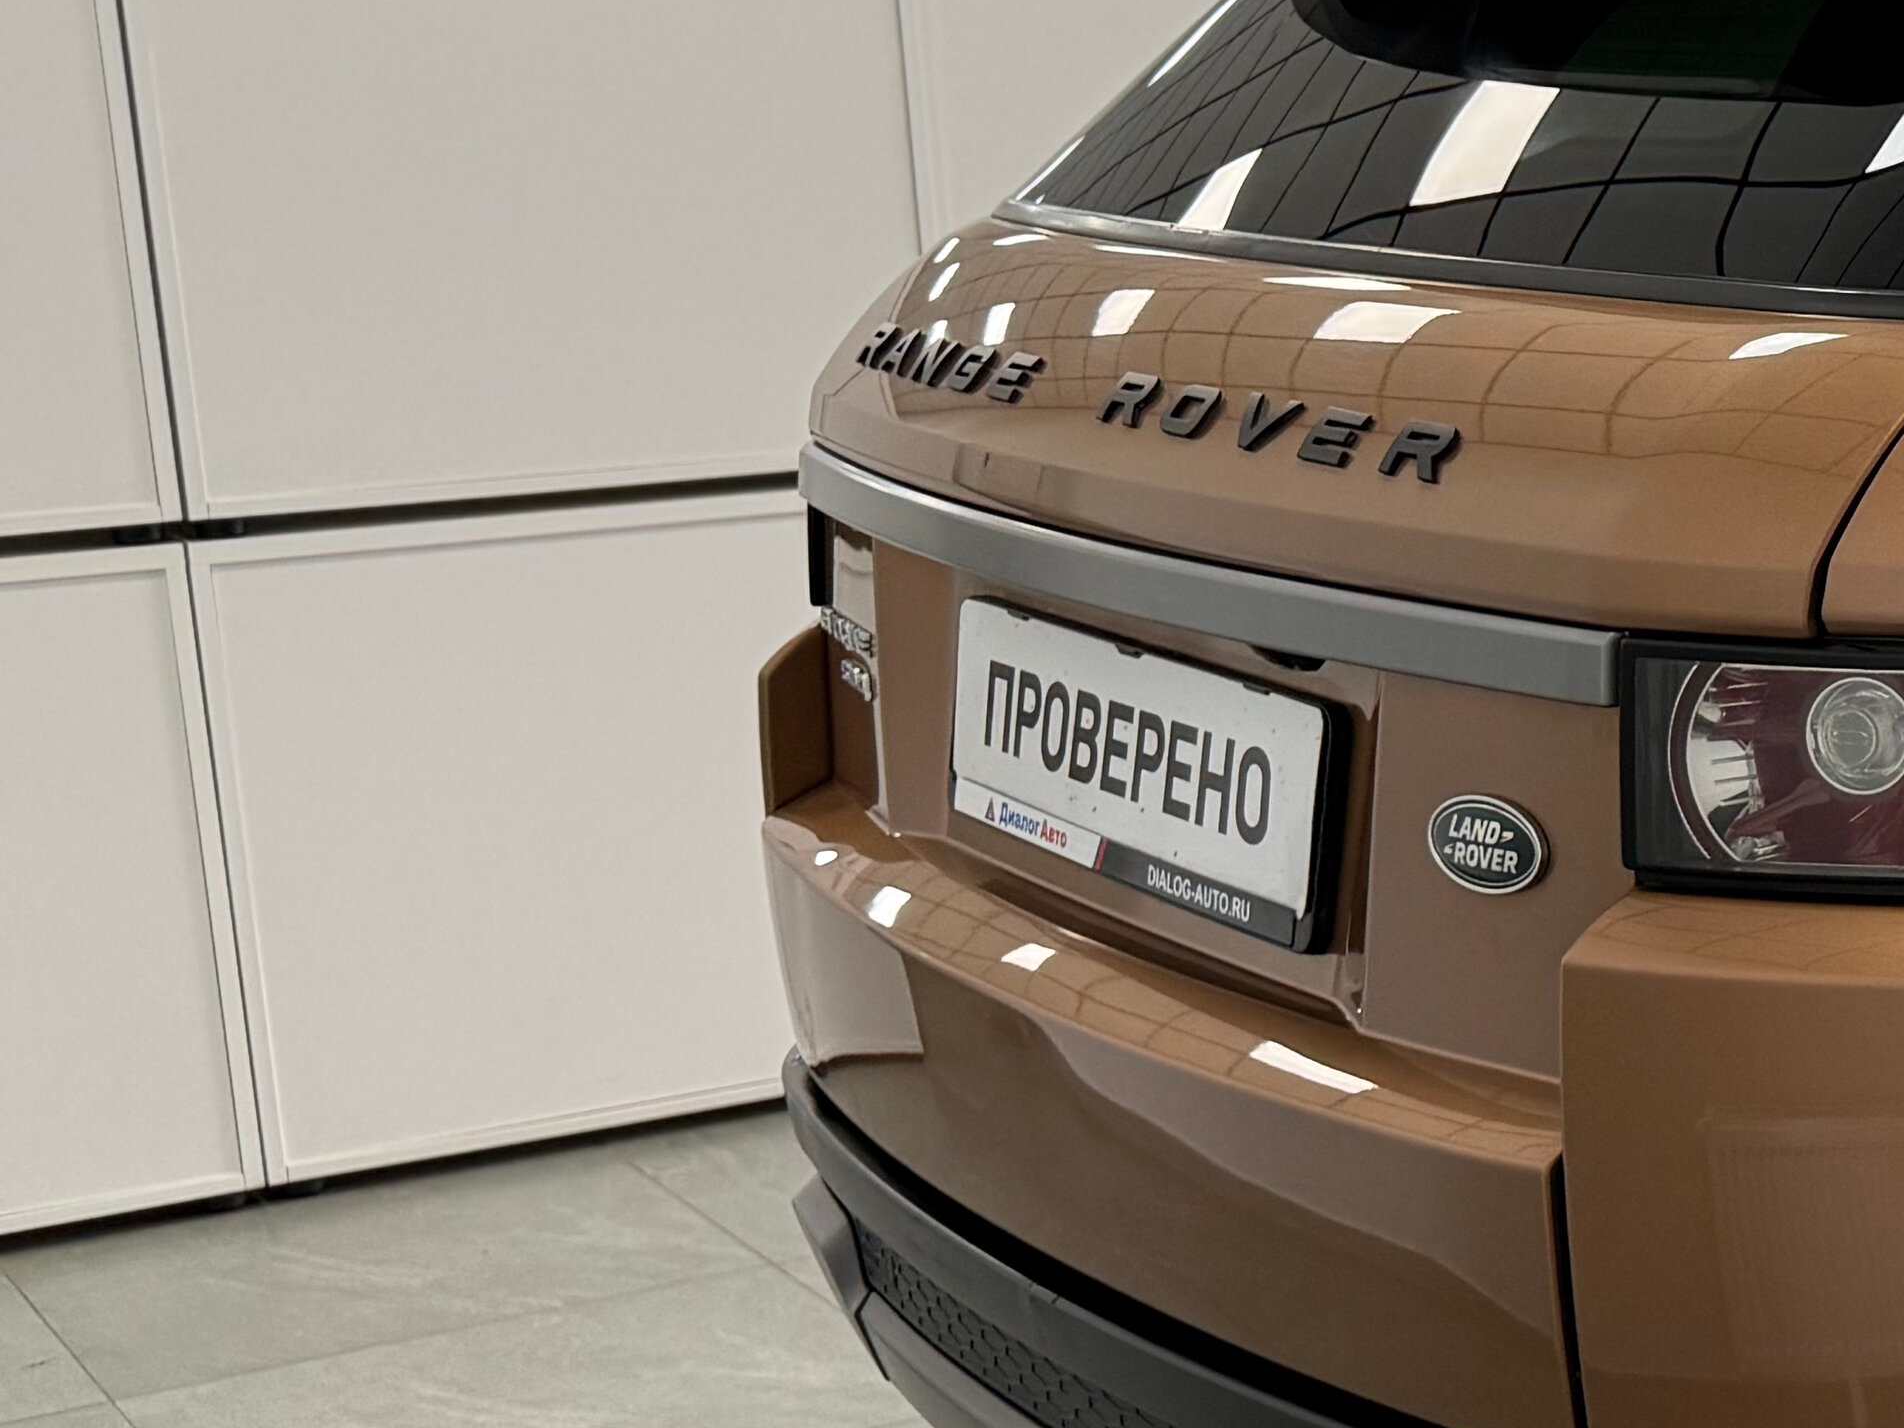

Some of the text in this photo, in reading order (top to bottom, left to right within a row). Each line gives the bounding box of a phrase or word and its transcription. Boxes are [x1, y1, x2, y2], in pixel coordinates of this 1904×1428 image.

[858, 322, 1461, 485] RANGE ROVER
[983, 659, 1272, 846] ПРОВЕРЕНО
[1448, 813, 1501, 845] LAND
[1453, 841, 1519, 874] ROVER
[1148, 864, 1251, 923] DIALOG-AUTO.RU
